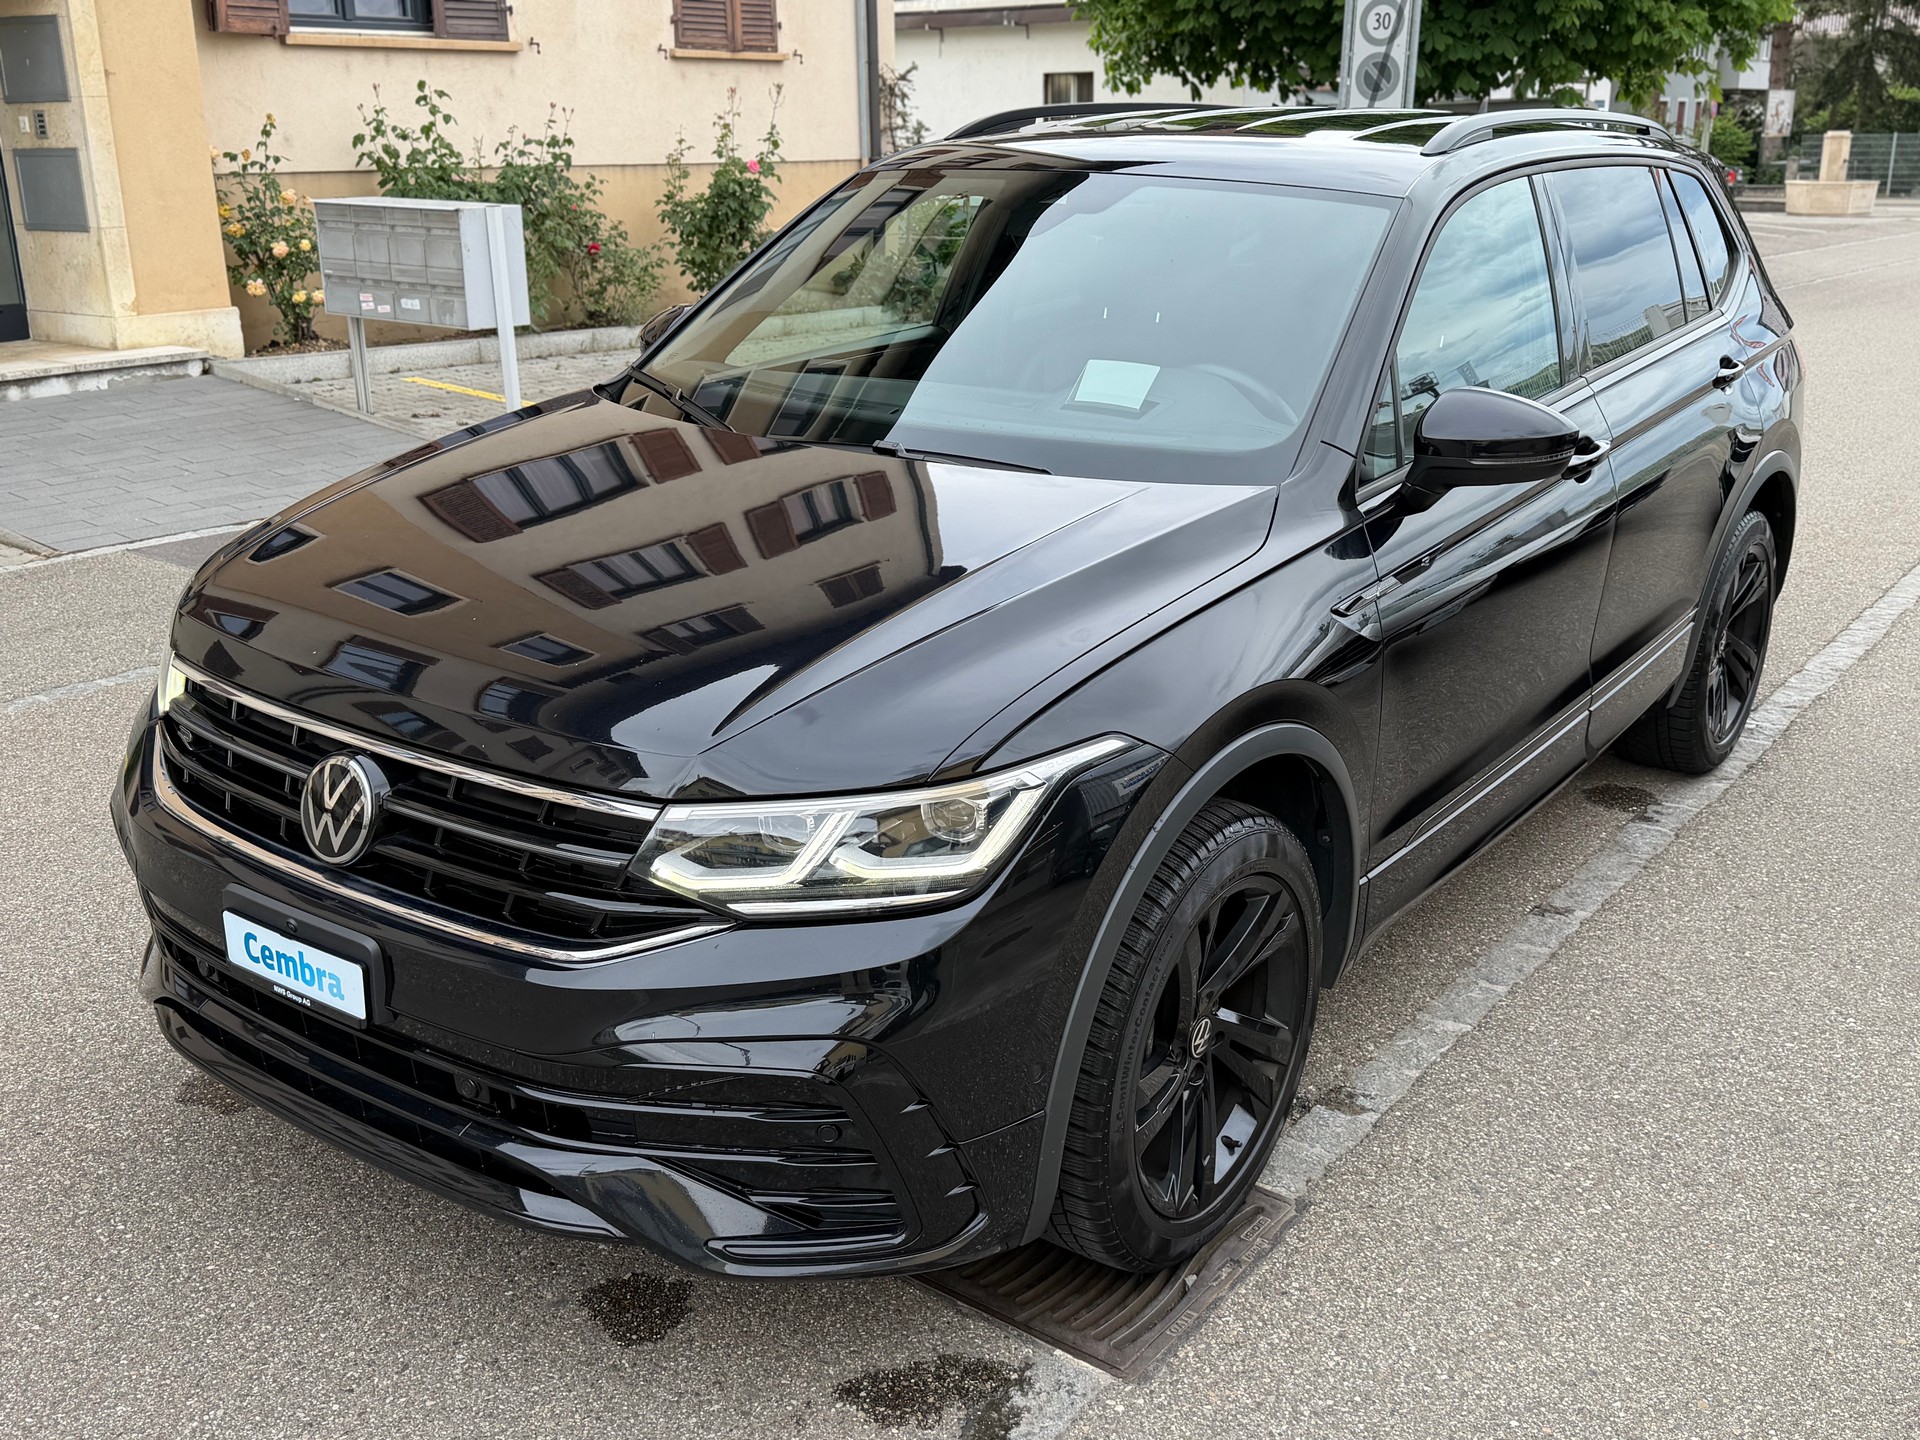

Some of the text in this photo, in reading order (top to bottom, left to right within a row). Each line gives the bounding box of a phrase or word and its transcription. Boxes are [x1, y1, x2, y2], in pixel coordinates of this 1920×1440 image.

[1373, 12, 1391, 30] 30
[243, 931, 345, 1001] Cembra
[286, 990, 302, 1003] Group
[303, 997, 311, 1006] AG
